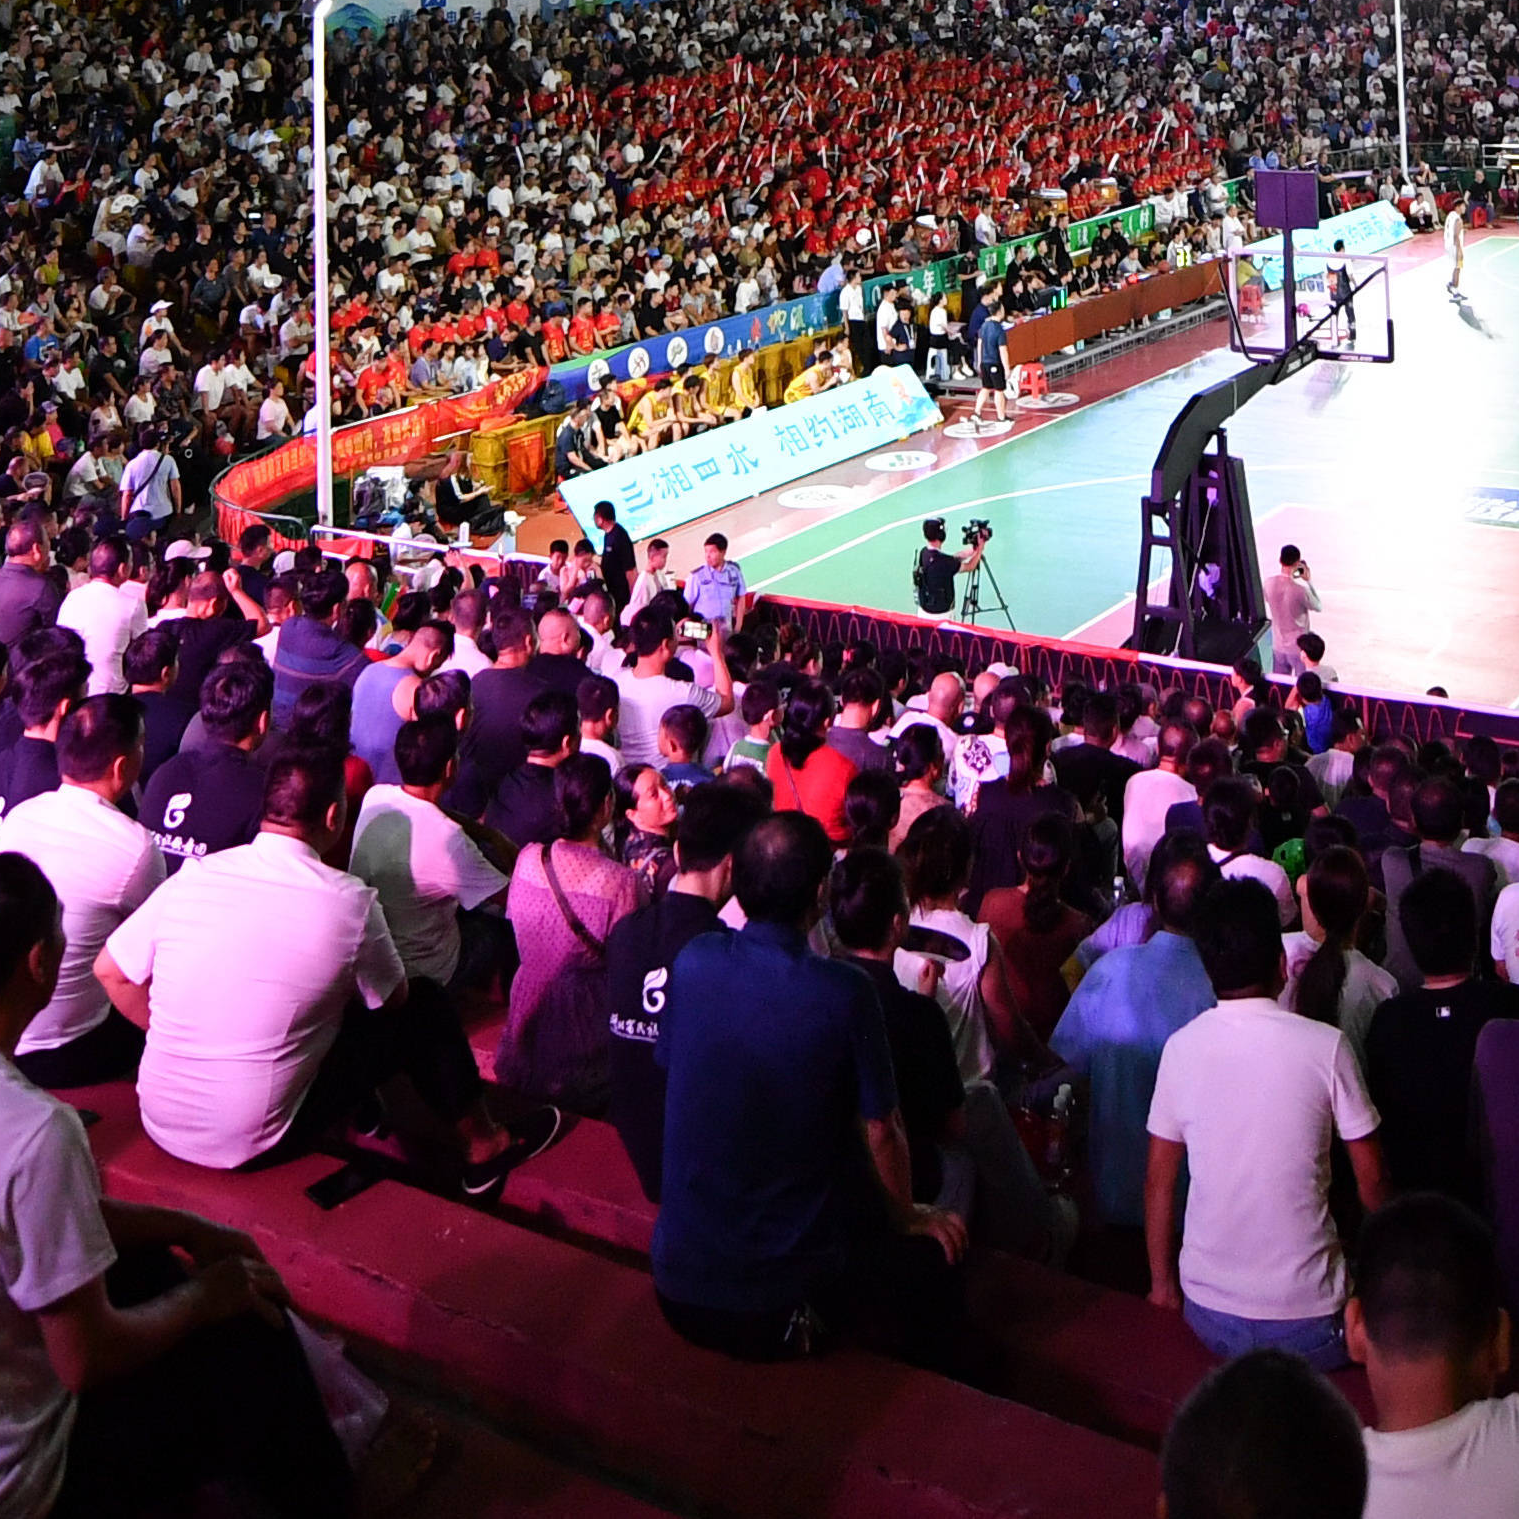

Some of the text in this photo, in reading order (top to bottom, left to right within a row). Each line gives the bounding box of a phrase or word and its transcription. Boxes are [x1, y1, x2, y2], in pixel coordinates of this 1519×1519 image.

[621, 389, 896, 514] 三湘四水 相约湖南
